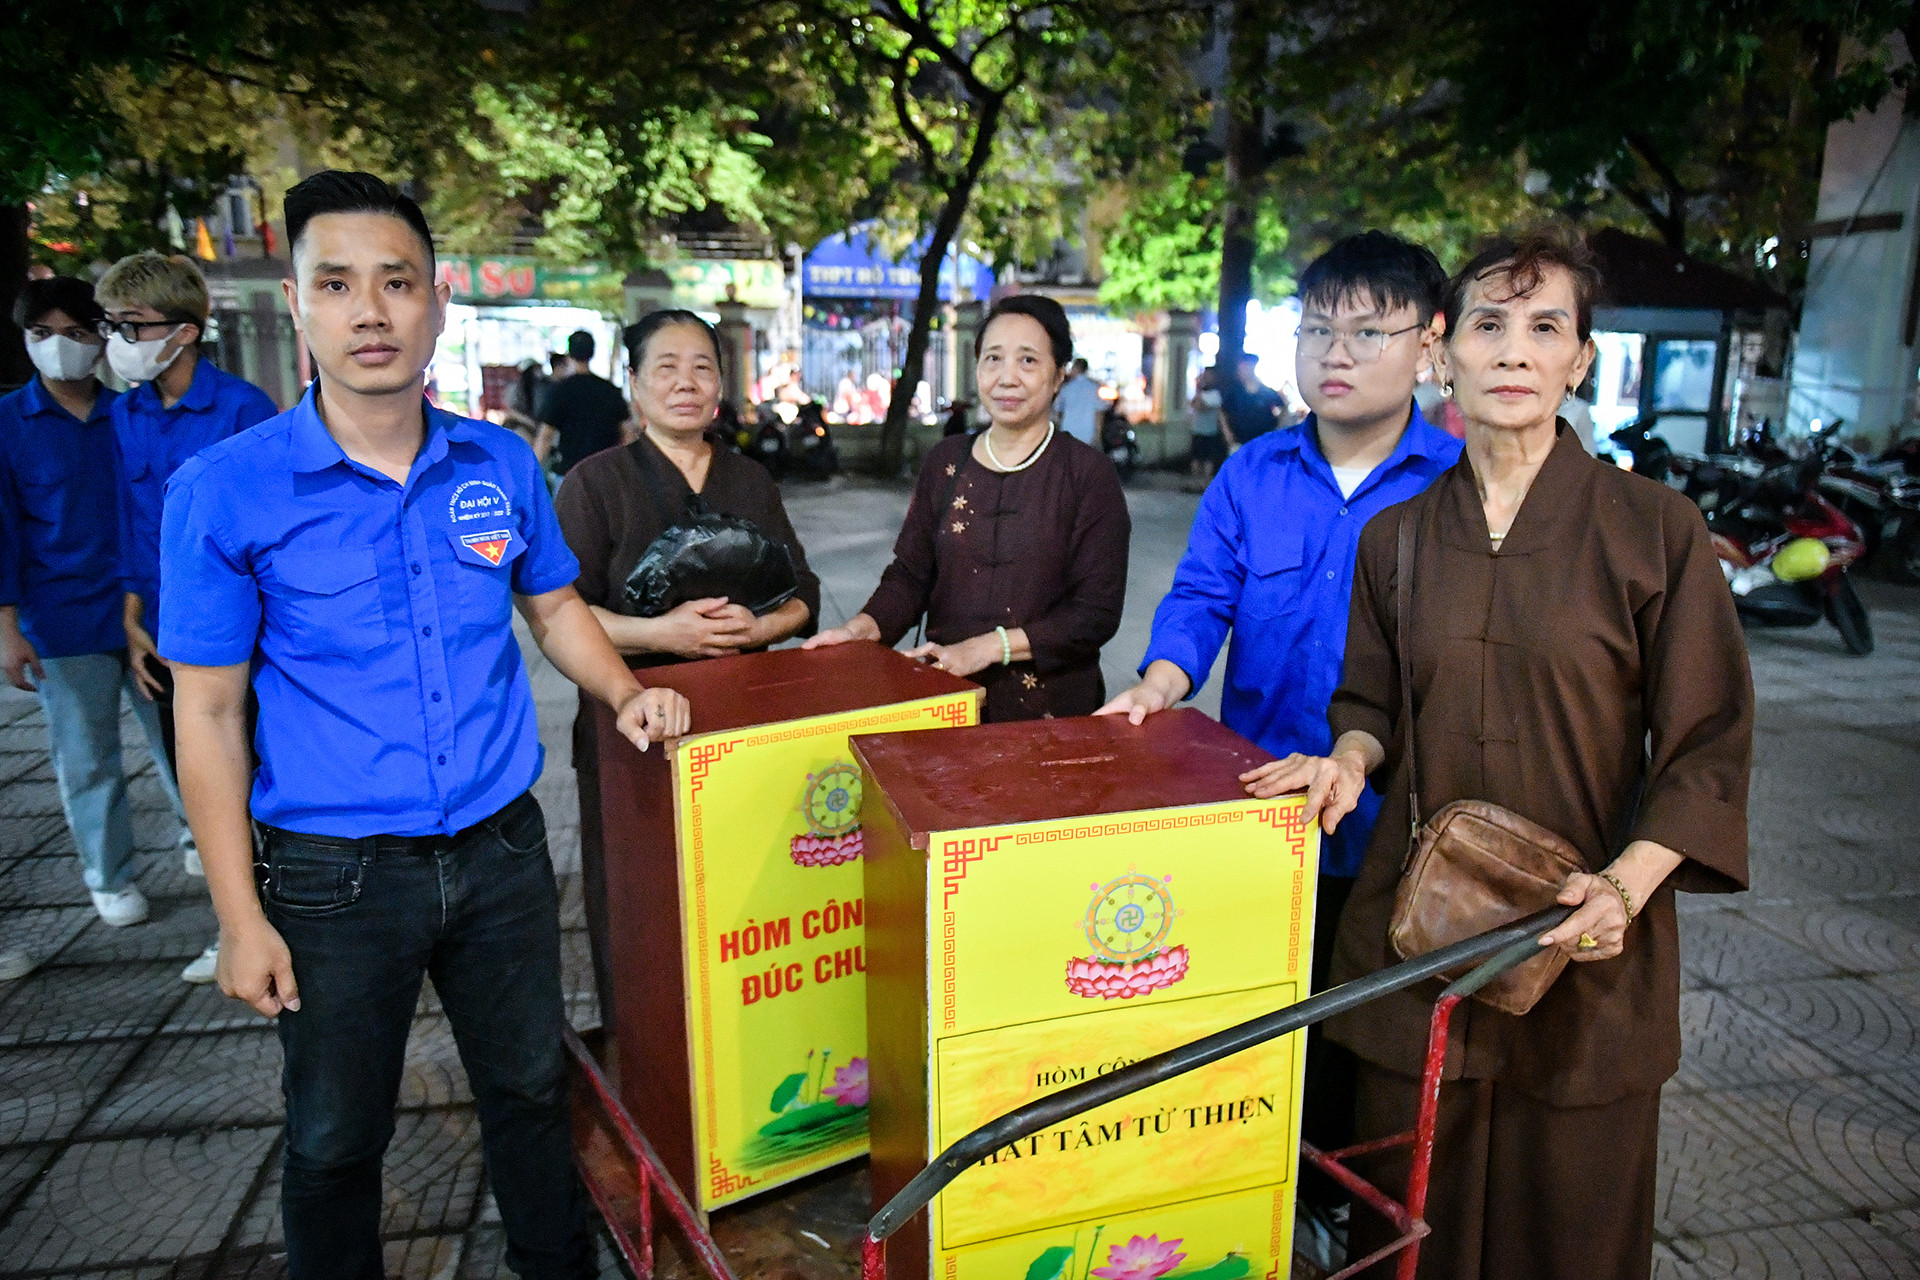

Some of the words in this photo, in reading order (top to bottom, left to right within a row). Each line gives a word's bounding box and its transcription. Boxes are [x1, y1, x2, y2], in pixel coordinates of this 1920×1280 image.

[460, 499, 475, 510] ĐẠI
[477, 496, 491, 508] HỘI
[719, 917, 791, 963] HÒM
[801, 898, 863, 940] CÔN
[741, 962, 804, 1006] ĐÚC
[814, 945, 867, 984] CHU
[1036, 1066, 1086, 1087] HÒM
[1097, 1056, 1143, 1077] CÔ
[1053, 1121, 1122, 1152] TÂM
[1133, 1107, 1177, 1137] TỪ
[1184, 1094, 1275, 1129] THIỆN
